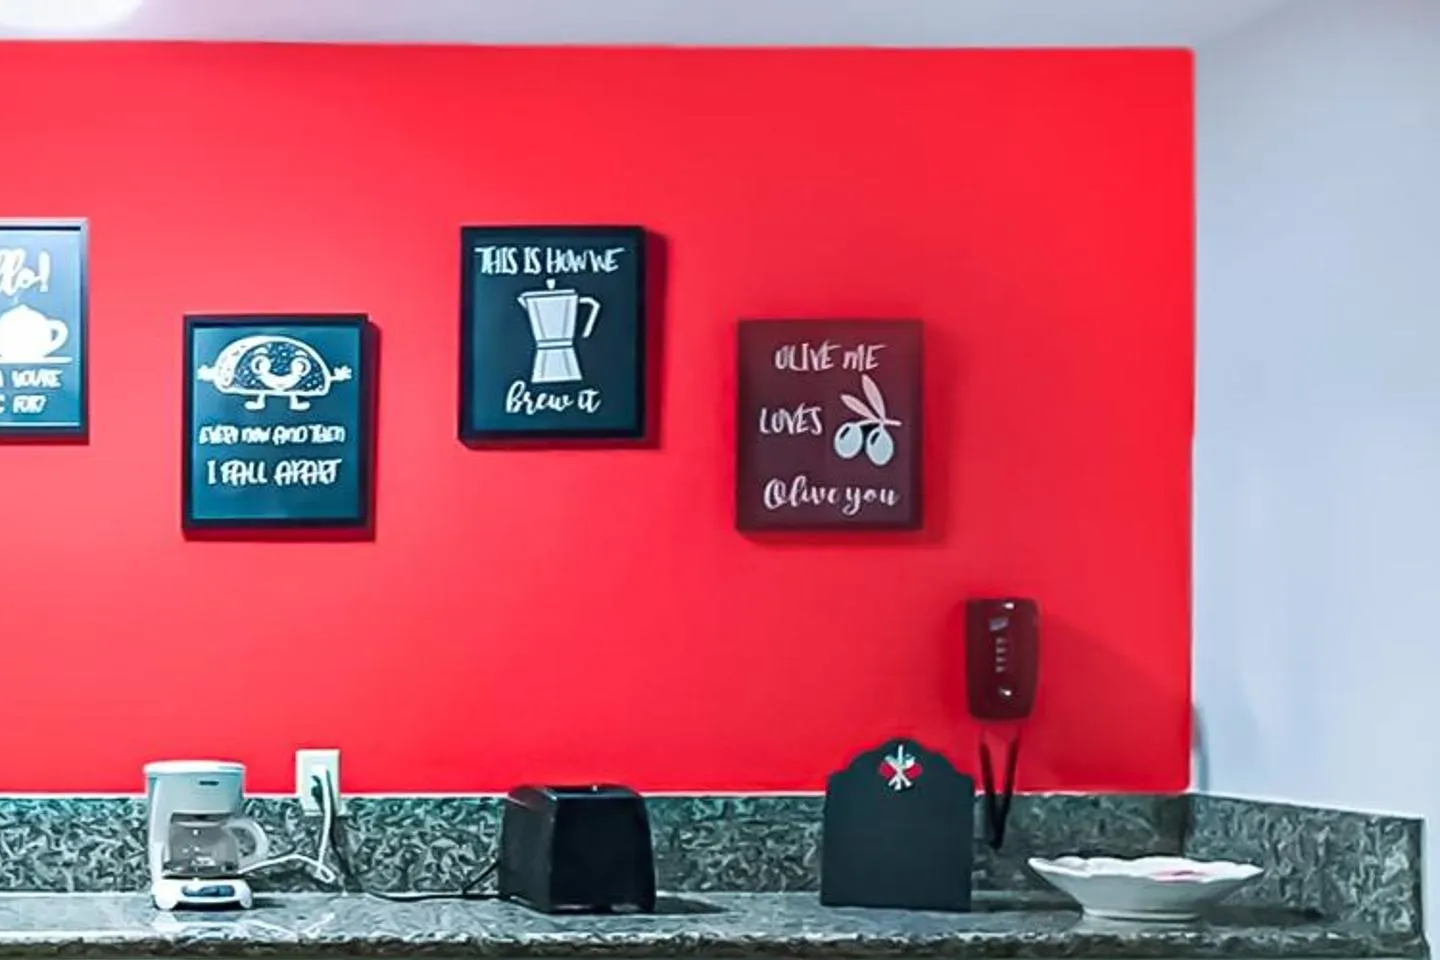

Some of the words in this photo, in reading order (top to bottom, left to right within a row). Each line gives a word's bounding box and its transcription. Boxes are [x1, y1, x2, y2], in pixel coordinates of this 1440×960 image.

[474, 246, 518, 274] THIS
[523, 246, 541, 274] IS
[775, 340, 841, 371] OLIVE
[842, 344, 887, 372] ME
[578, 388, 601, 414] it
[760, 402, 823, 435] LOVES
[241, 426, 272, 443] NOW
[272, 425, 308, 445] AND
[308, 424, 346, 443] THEN
[207, 460, 217, 485] I
[220, 460, 268, 486] FALL
[274, 458, 343, 486] APART
[763, 475, 838, 510] Olive
[842, 487, 898, 516] you
